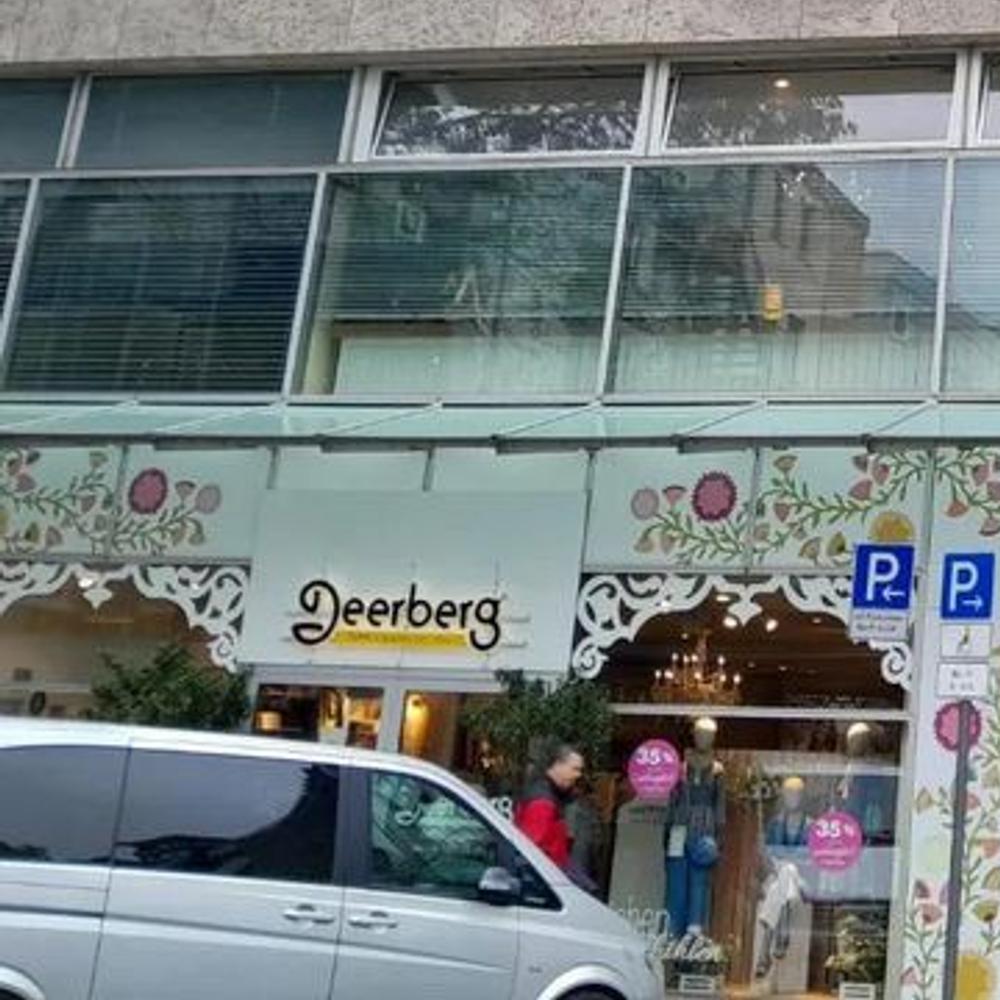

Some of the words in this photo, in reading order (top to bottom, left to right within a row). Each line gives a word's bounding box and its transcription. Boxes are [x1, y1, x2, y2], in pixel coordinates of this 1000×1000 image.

[866, 552, 900, 601] P
[949, 561, 979, 611] P
[292, 580, 501, 650] Deerberg
